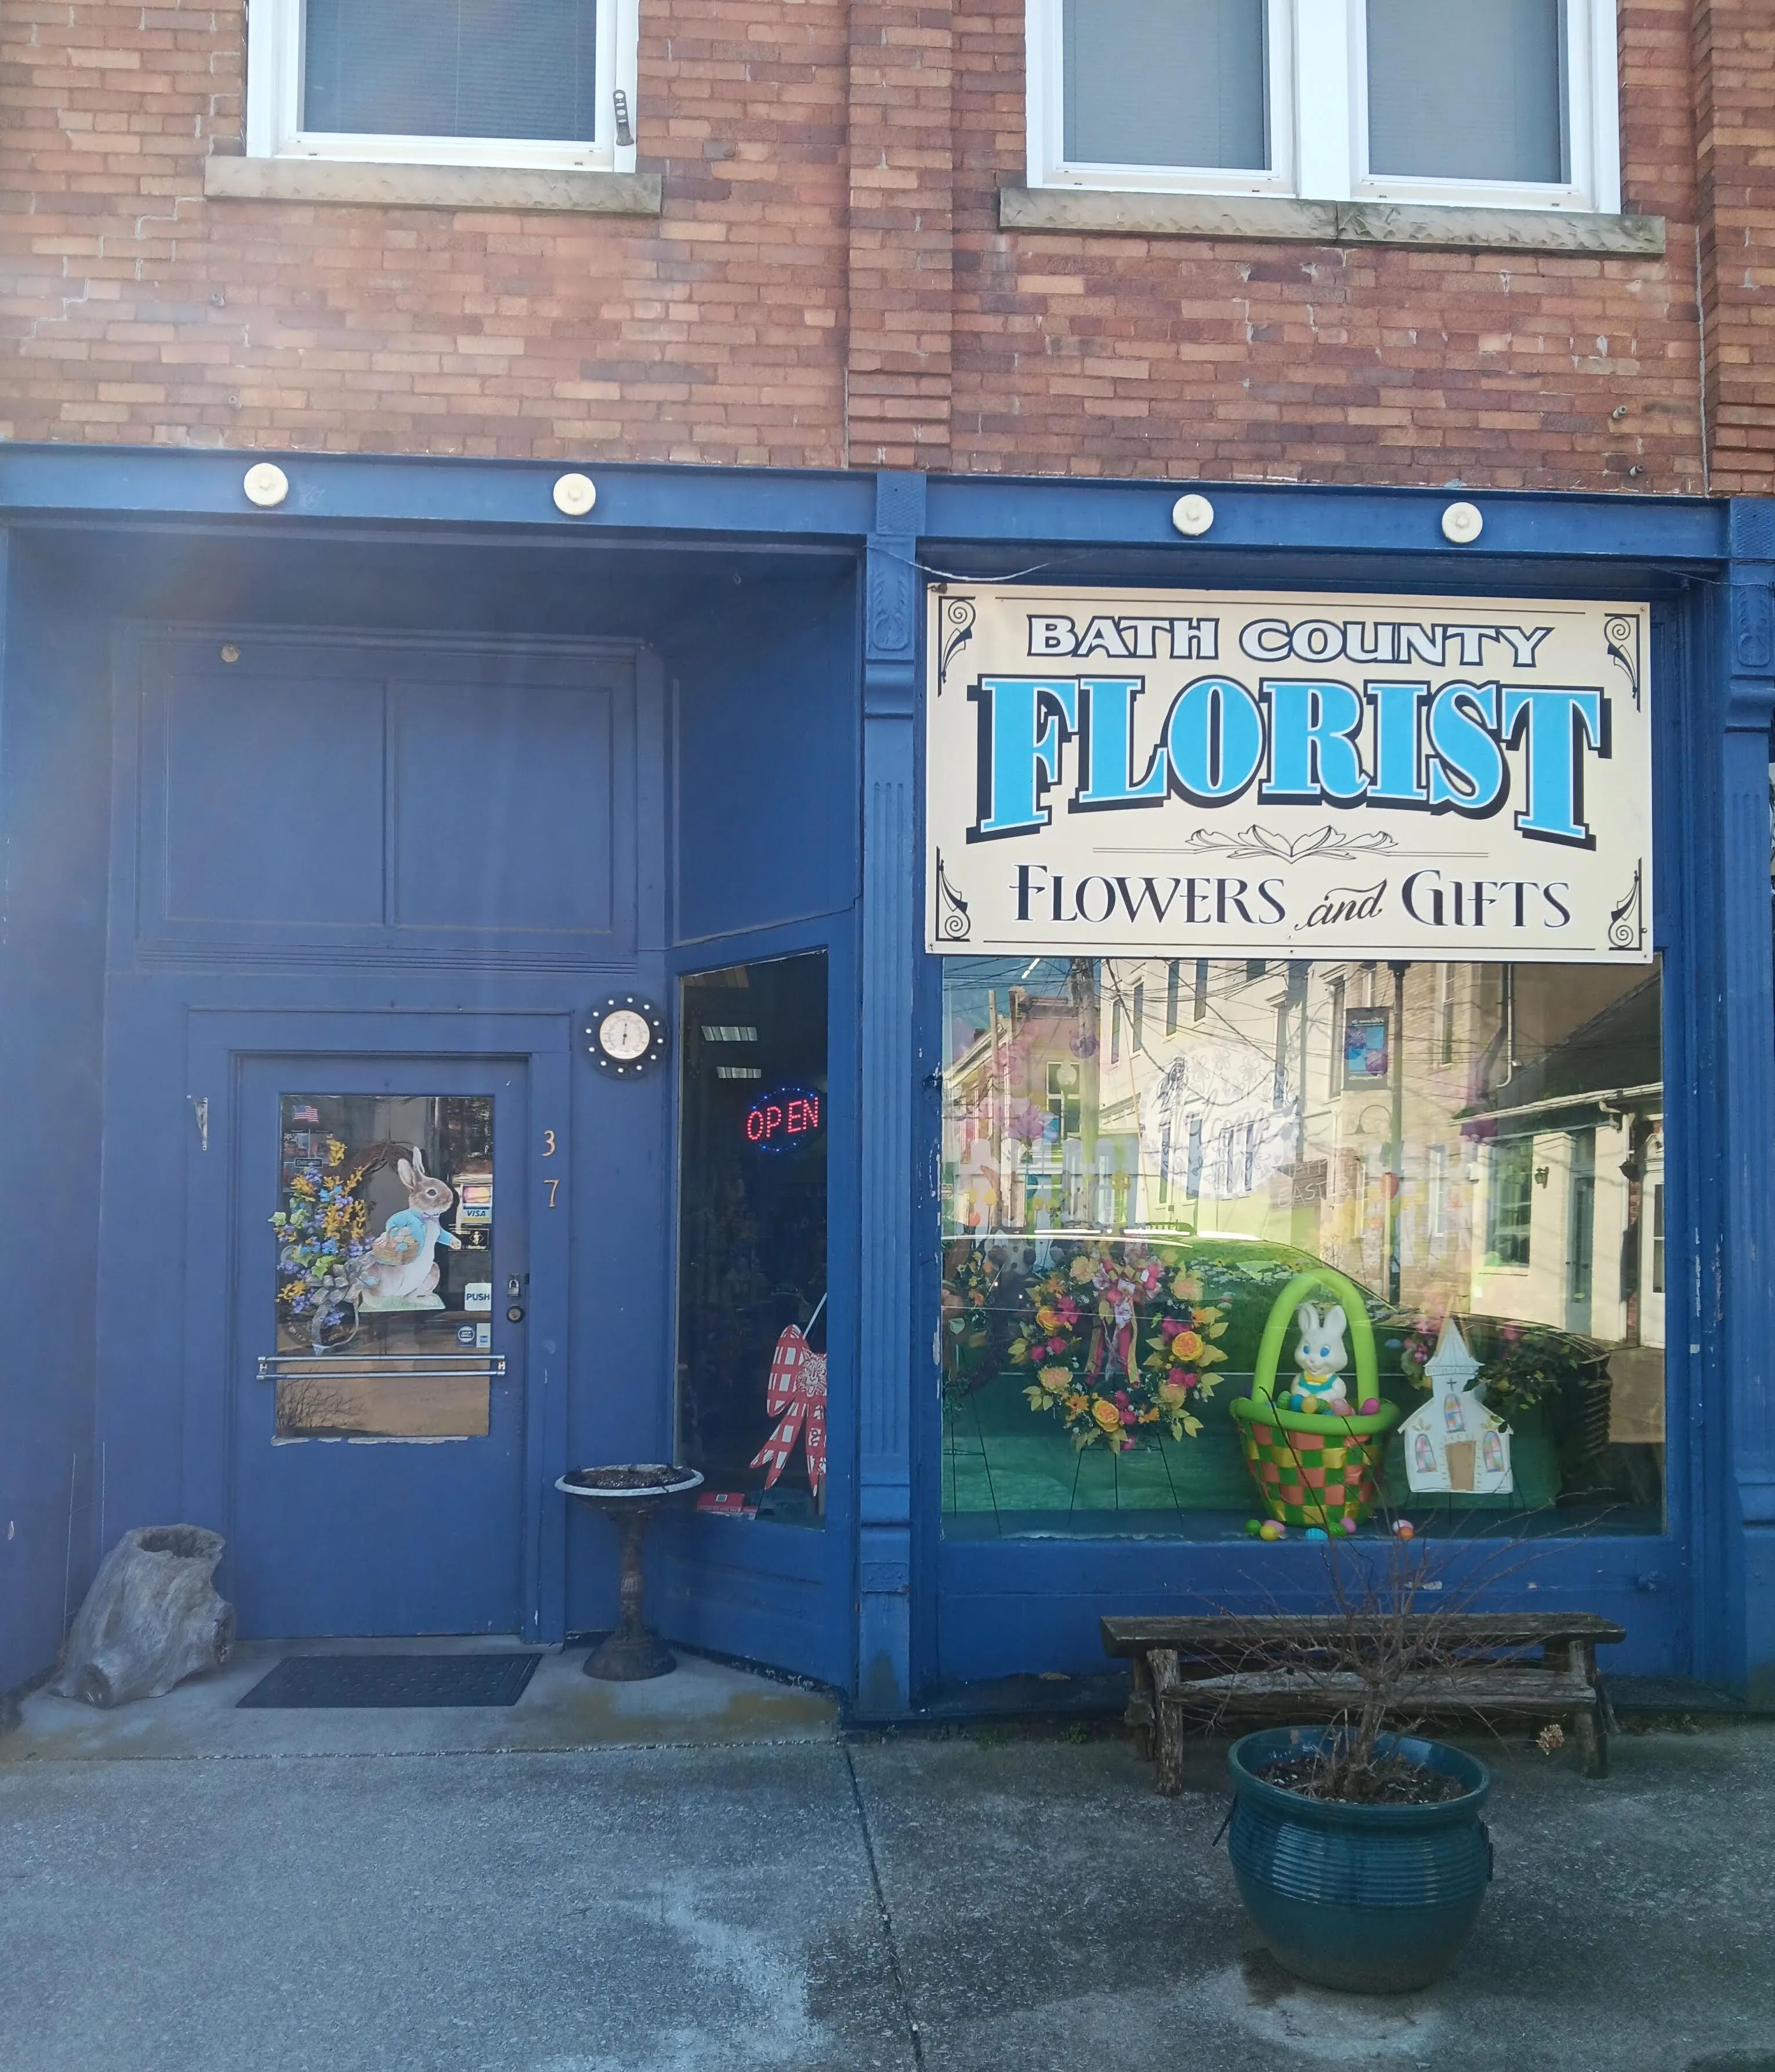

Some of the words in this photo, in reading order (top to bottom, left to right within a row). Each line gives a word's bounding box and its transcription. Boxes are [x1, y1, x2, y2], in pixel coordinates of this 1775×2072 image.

[1026, 614, 1220, 660] BATH
[1238, 618, 1556, 668] COUNTY
[966, 674, 1613, 853] FLORIST
[1009, 864, 1286, 925] FLOWERS
[1295, 878, 1388, 931] and
[1401, 870, 1571, 928] GIFTS
[747, 1096, 819, 1141] OPEN
[466, 1209, 486, 1218] VISA
[466, 1292, 491, 1301] PUSH
